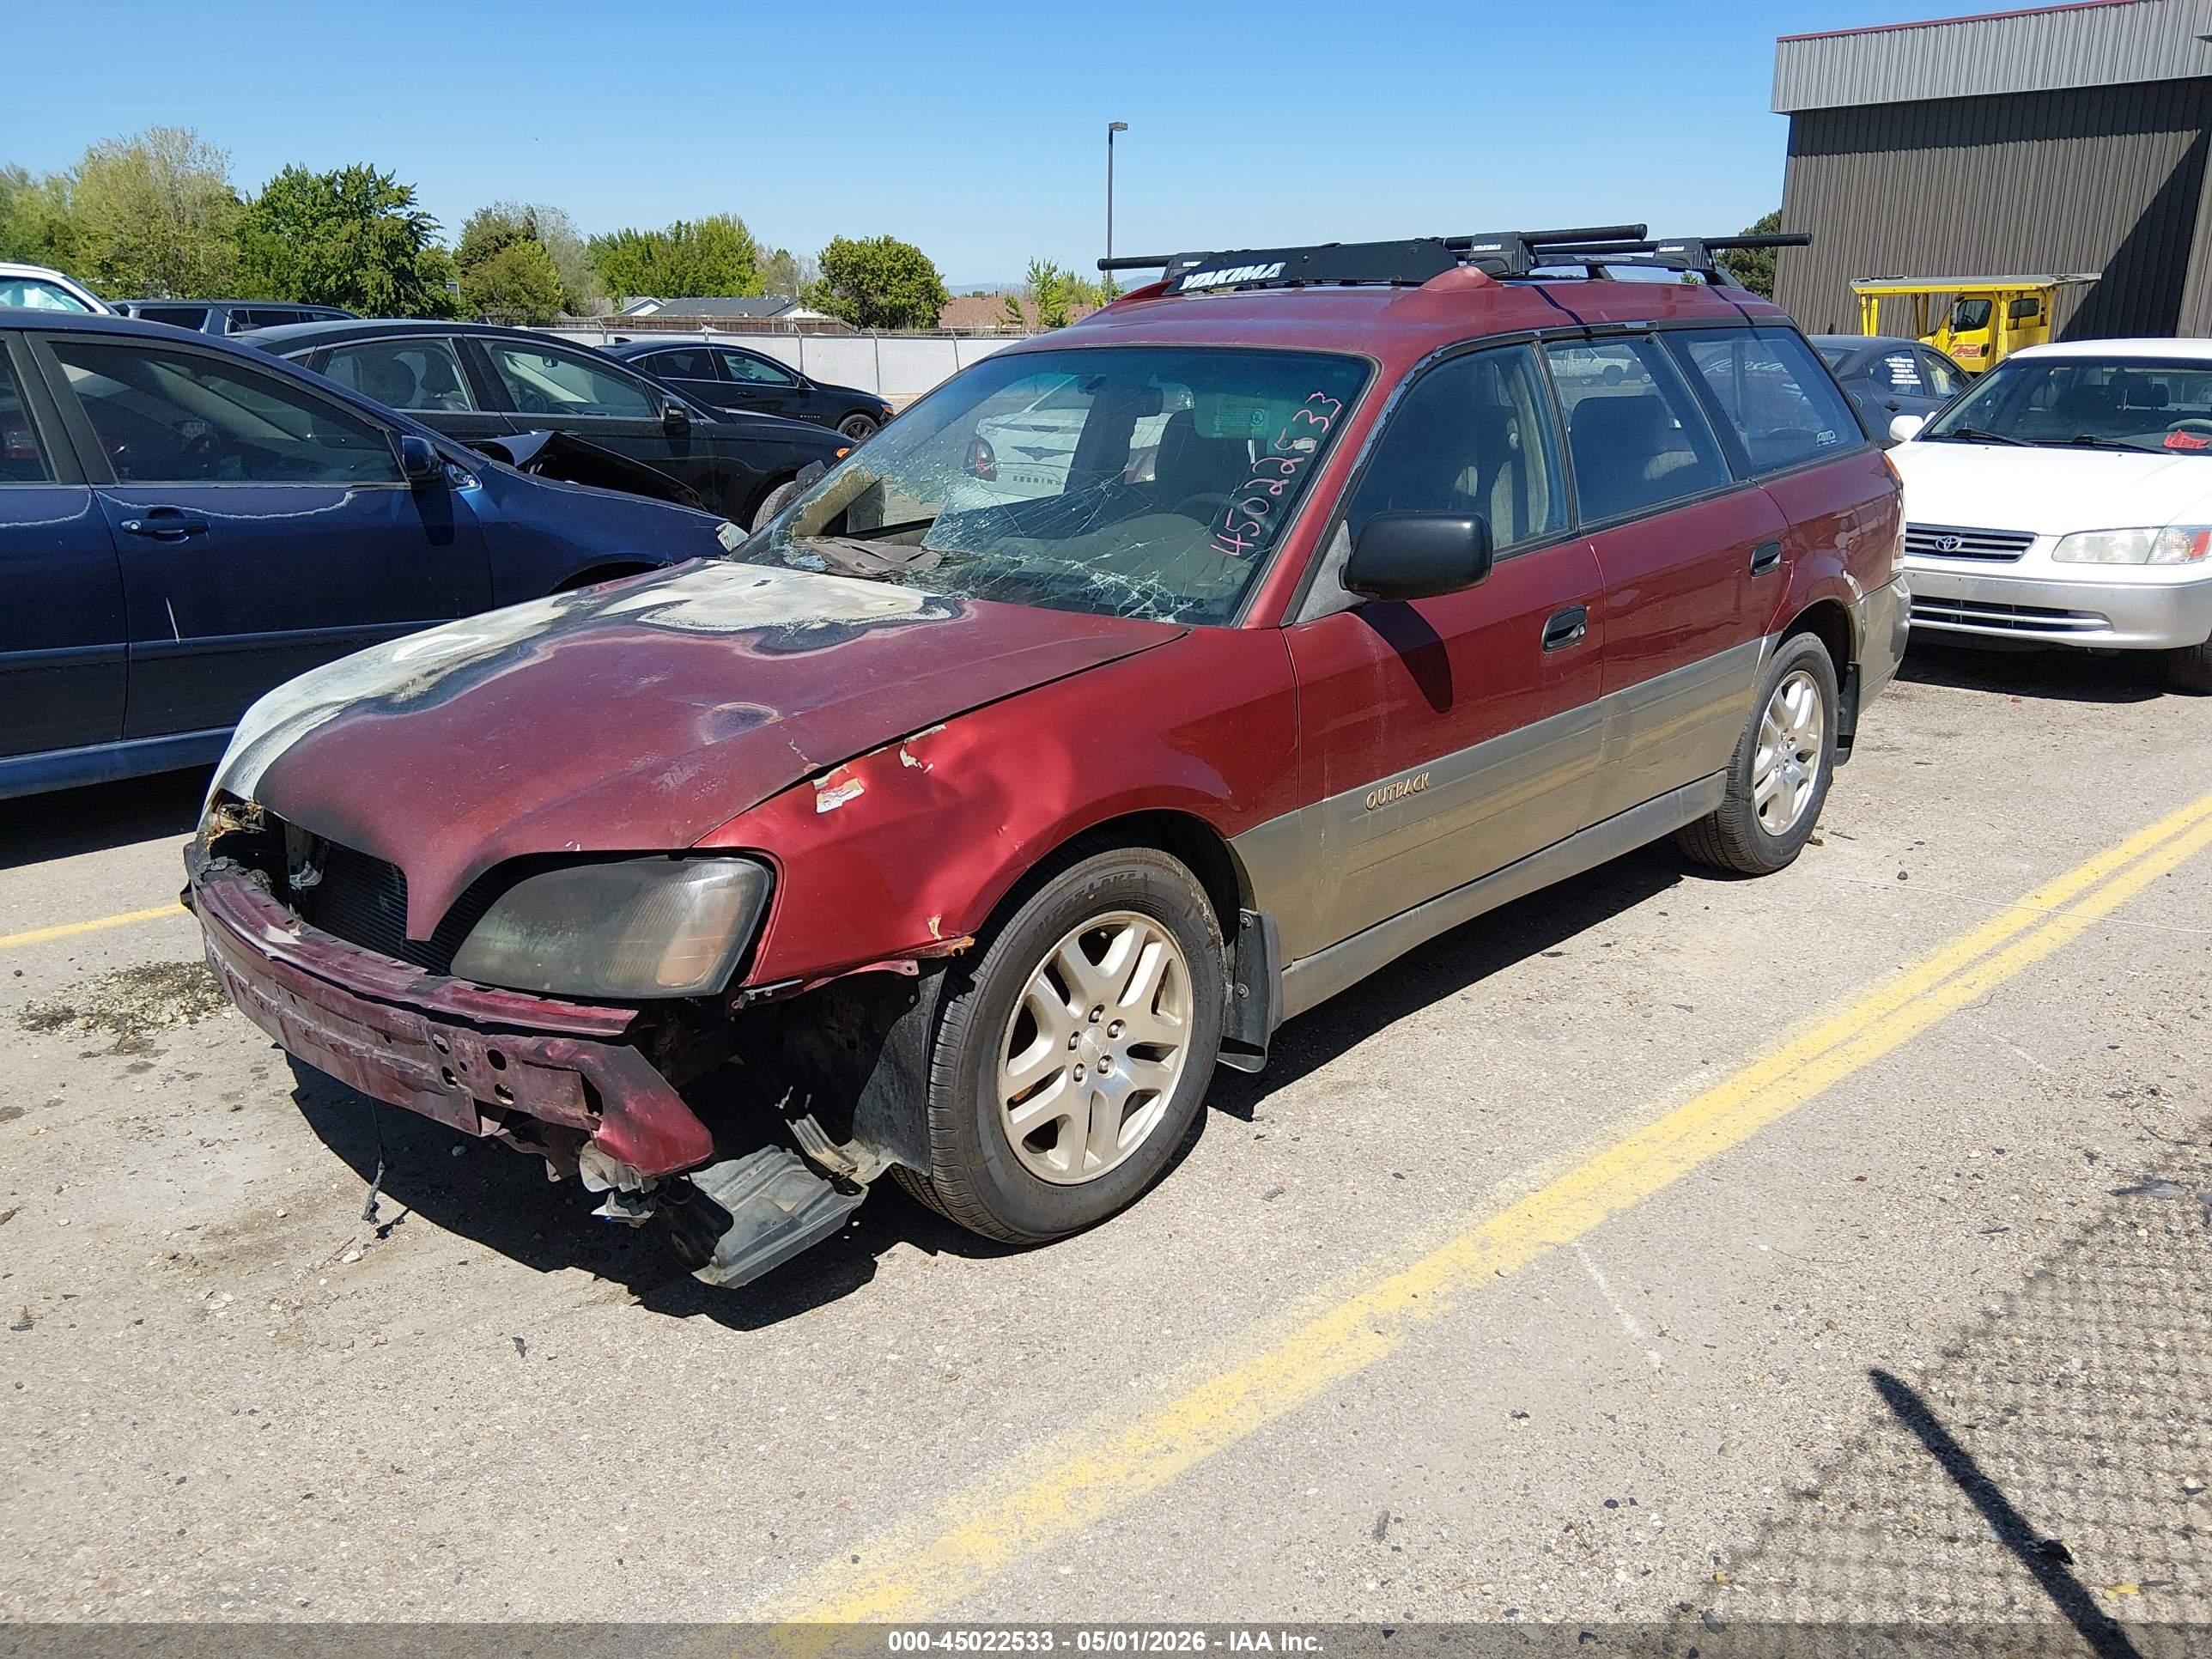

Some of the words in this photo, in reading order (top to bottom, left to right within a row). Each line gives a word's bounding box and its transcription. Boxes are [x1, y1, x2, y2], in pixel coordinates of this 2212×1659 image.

[1178, 262, 1286, 290] YAKIMA
[1209, 391, 1343, 556] 45022533
[1365, 771, 1430, 811] OUTBACK
